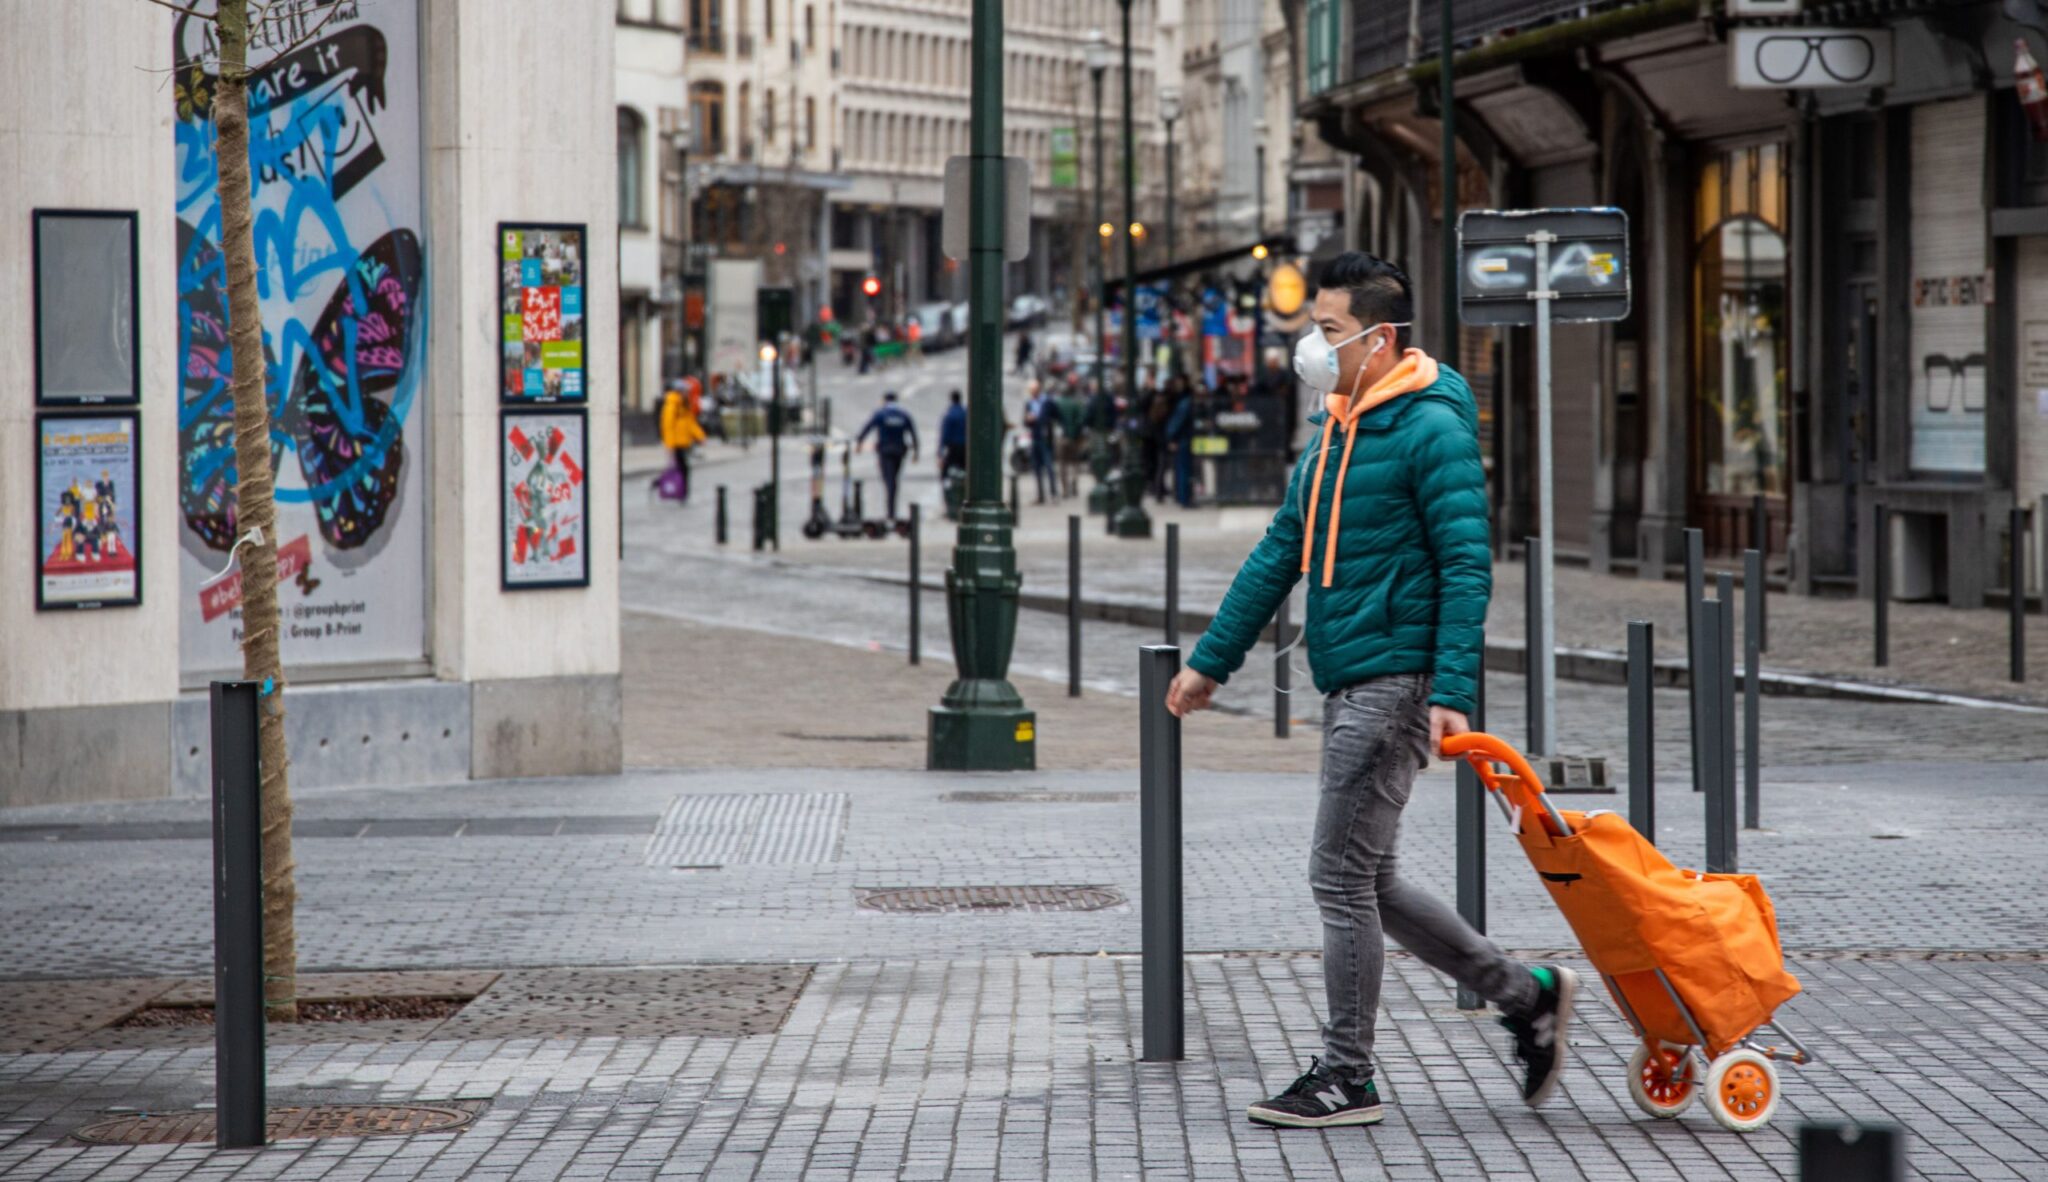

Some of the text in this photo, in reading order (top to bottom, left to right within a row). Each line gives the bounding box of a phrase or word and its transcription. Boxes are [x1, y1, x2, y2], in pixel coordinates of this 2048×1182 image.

[315, 44, 340, 74] it
[259, 141, 307, 184] us!
[291, 623, 322, 640] Group
[325, 622, 362, 638] B-Print
[1315, 1084, 1350, 1112] N
